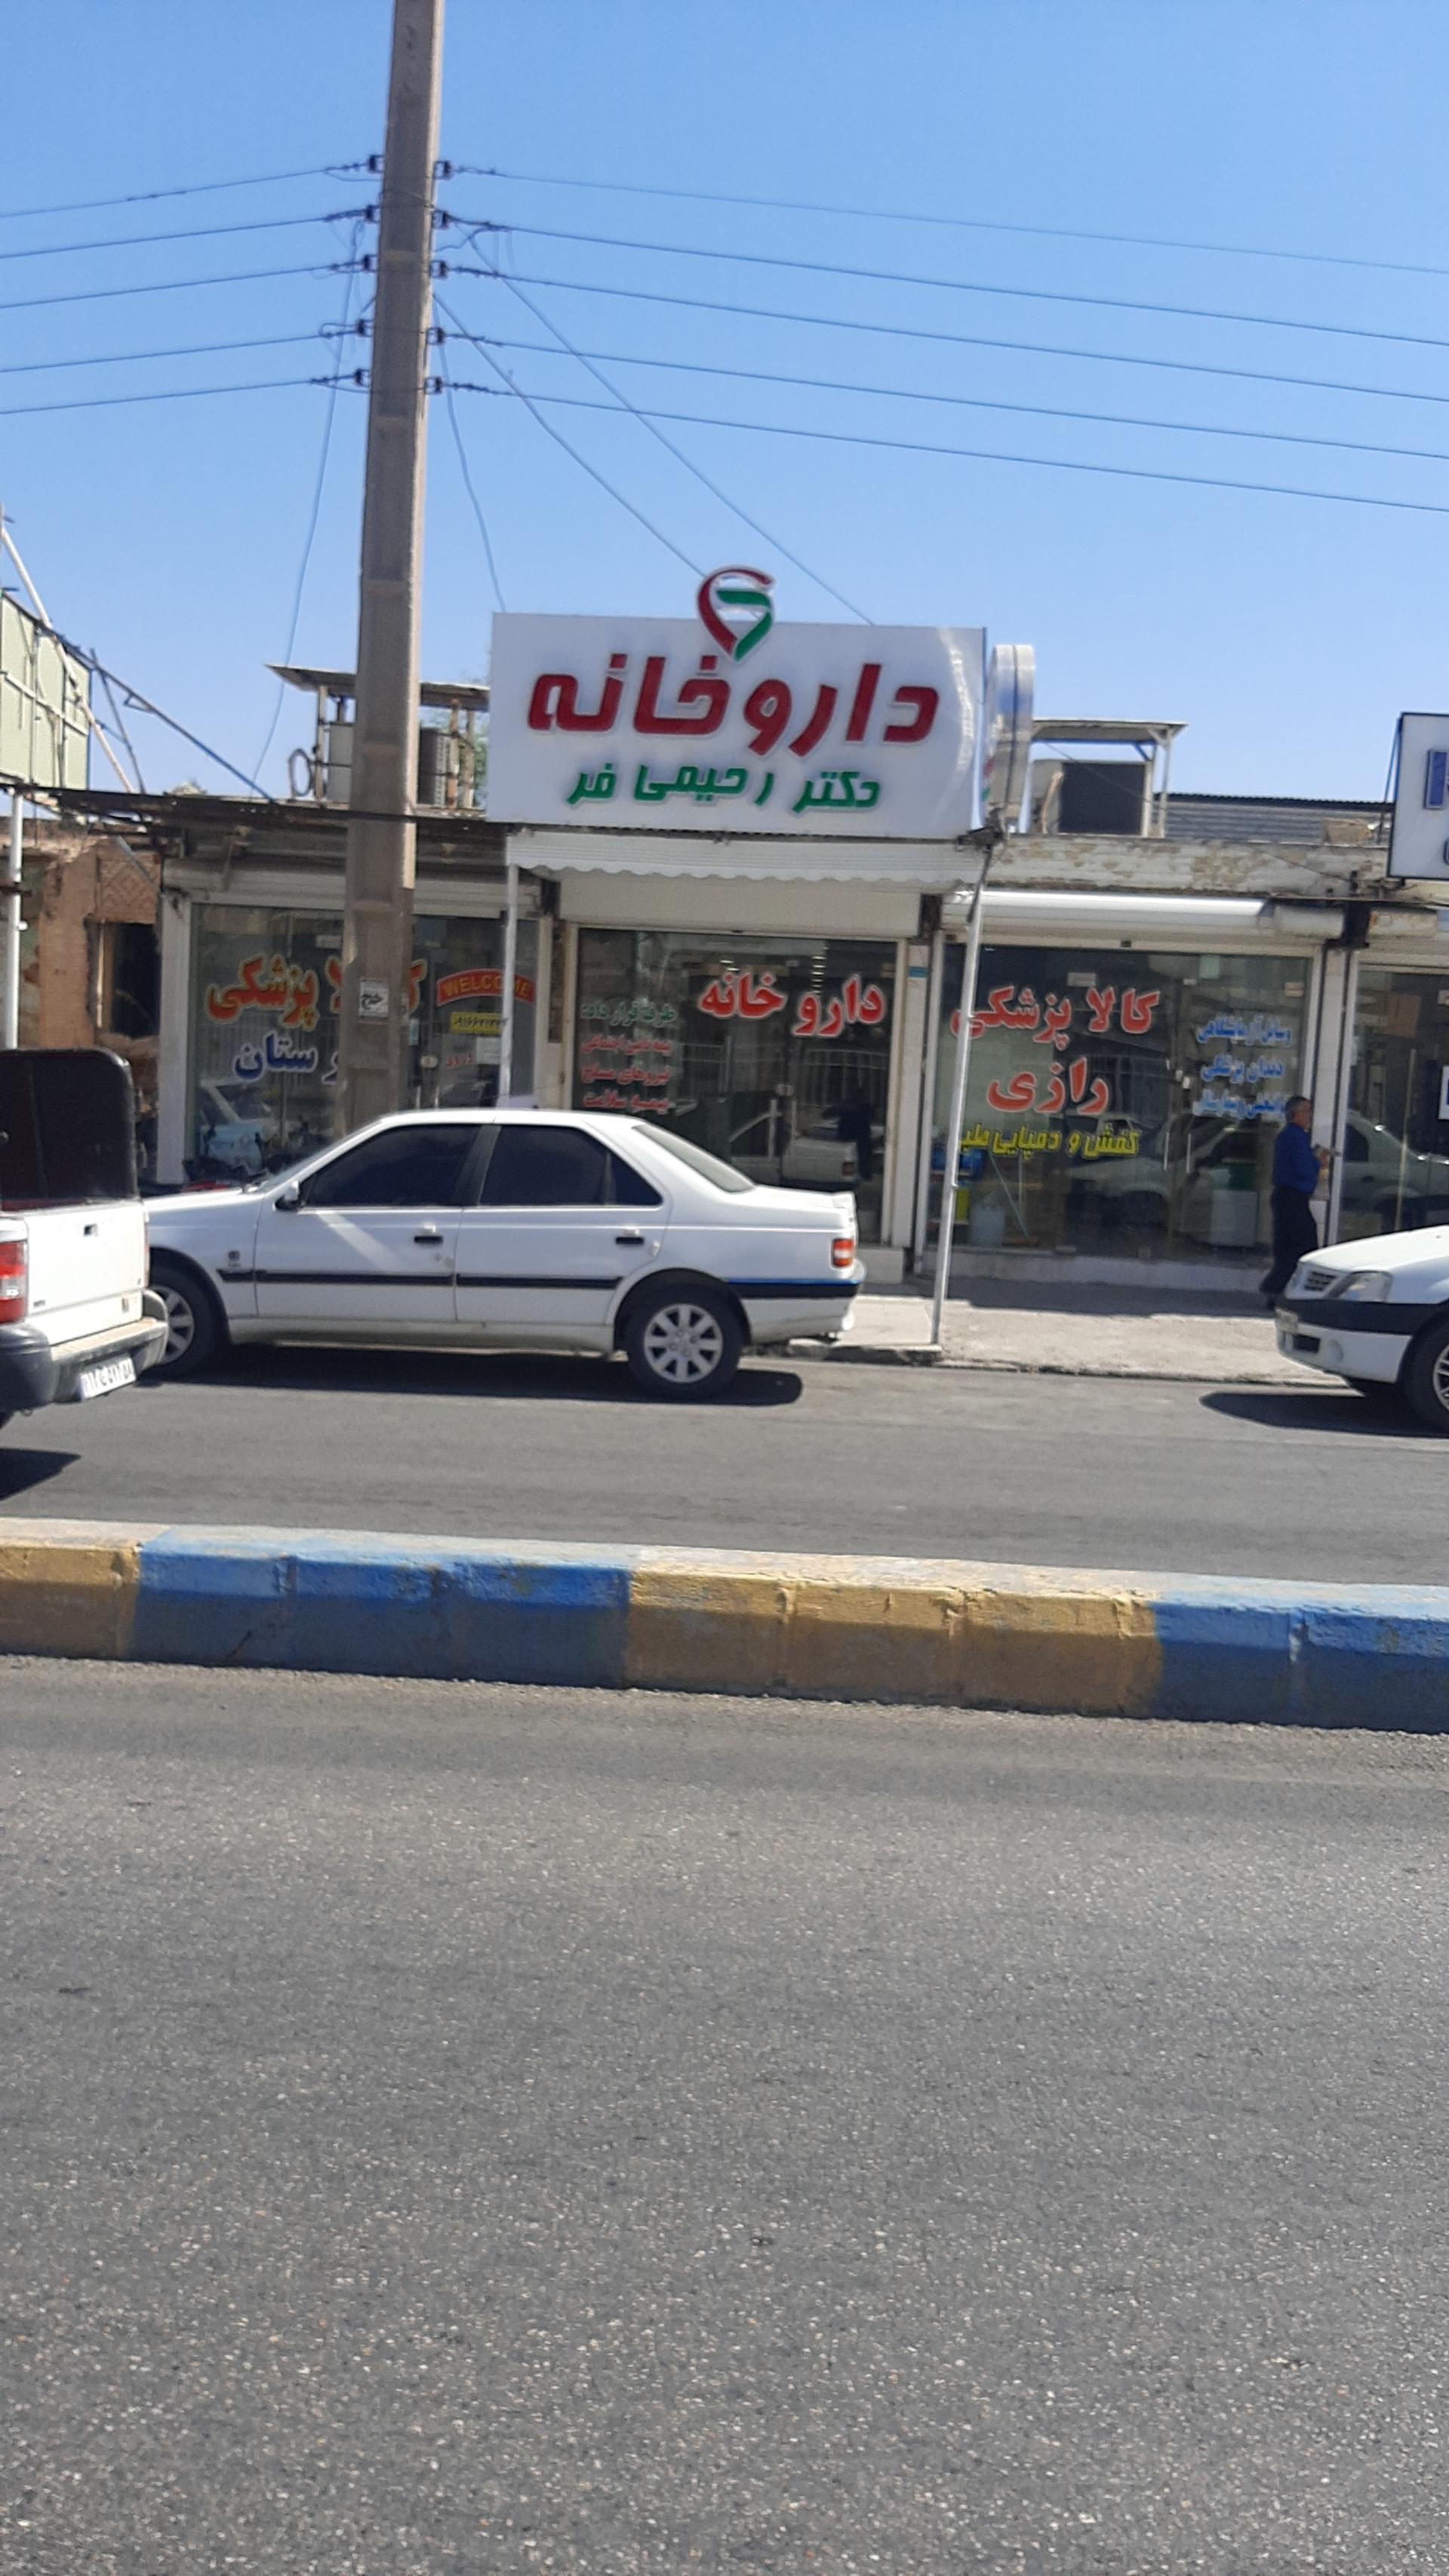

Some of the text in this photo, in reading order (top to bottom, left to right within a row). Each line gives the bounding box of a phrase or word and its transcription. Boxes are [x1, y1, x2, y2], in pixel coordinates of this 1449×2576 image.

[528, 653, 940, 757] داروخانه
[566, 762, 881, 814] دکتر رحیمی فر
[205, 953, 320, 1032] پزشکی
[697, 970, 887, 1038] دارو خانه
[950, 984, 1161, 1051] کالا پزشکی
[986, 1055, 1110, 1116] رازی
[959, 1122, 1140, 1163] کفش و دمپایی طب
